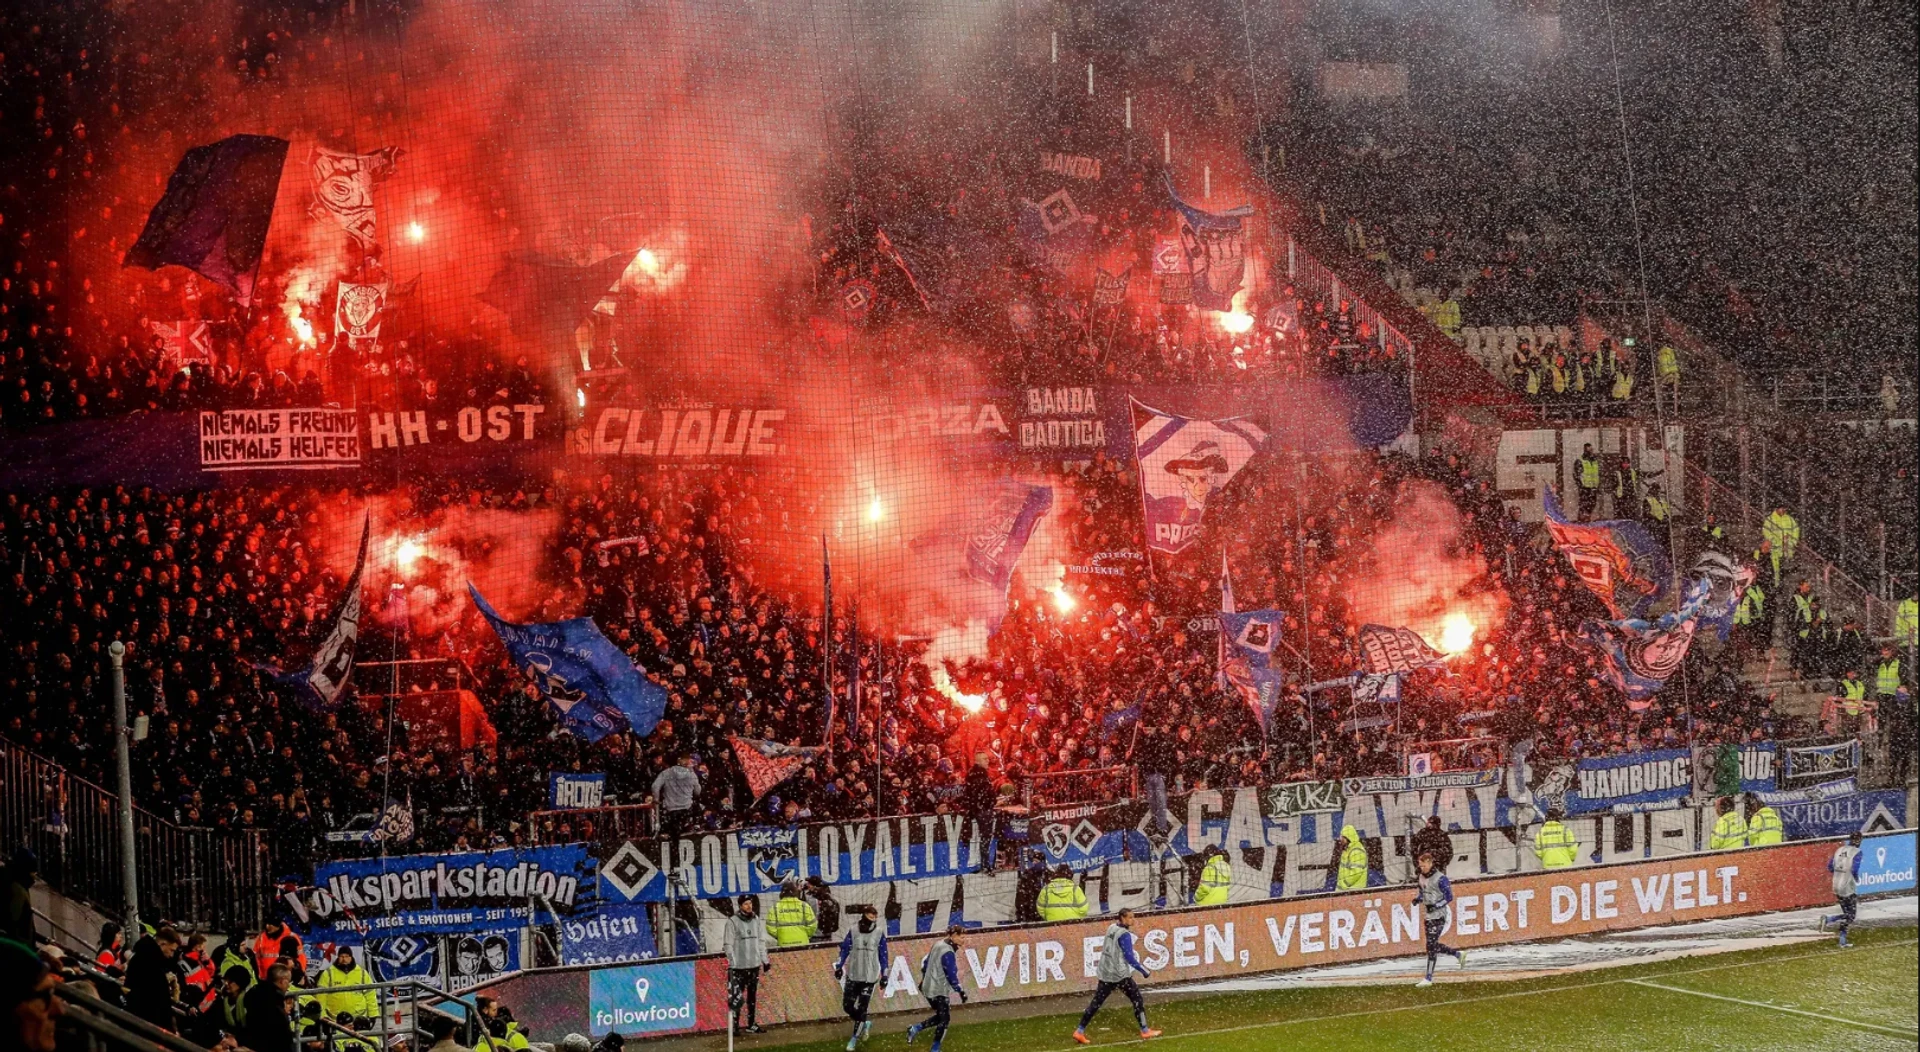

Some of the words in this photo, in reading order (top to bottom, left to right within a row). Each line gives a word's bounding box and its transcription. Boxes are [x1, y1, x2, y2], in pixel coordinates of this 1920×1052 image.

[1027, 387, 1097, 415] BANDA
[202, 412, 281, 437] NIEMALS
[289, 411, 356, 434] FREUND
[1019, 420, 1106, 448] CAOTICA
[203, 438, 282, 461] NIEMALS
[289, 437, 358, 459] HELFER
[1365, 780, 1407, 791] SEKTION
[1044, 805, 1098, 822] HAMBURG
[1782, 800, 1865, 825] SCHOLLI
[661, 832, 751, 899] IRON
[797, 814, 964, 886] LOYALTY
[1855, 867, 1913, 887] ollowfood
[284, 862, 578, 924] Volksparkstadion
[375, 916, 405, 929] SIEGE
[408, 916, 415, 925] &
[418, 912, 473, 925] EMOTIONEN
[486, 909, 506, 922] SEIT
[965, 940, 1067, 989] WIR
[1551, 879, 1618, 925] DIE
[1631, 865, 1747, 914] WELT.
[596, 1001, 690, 1027] followfood
